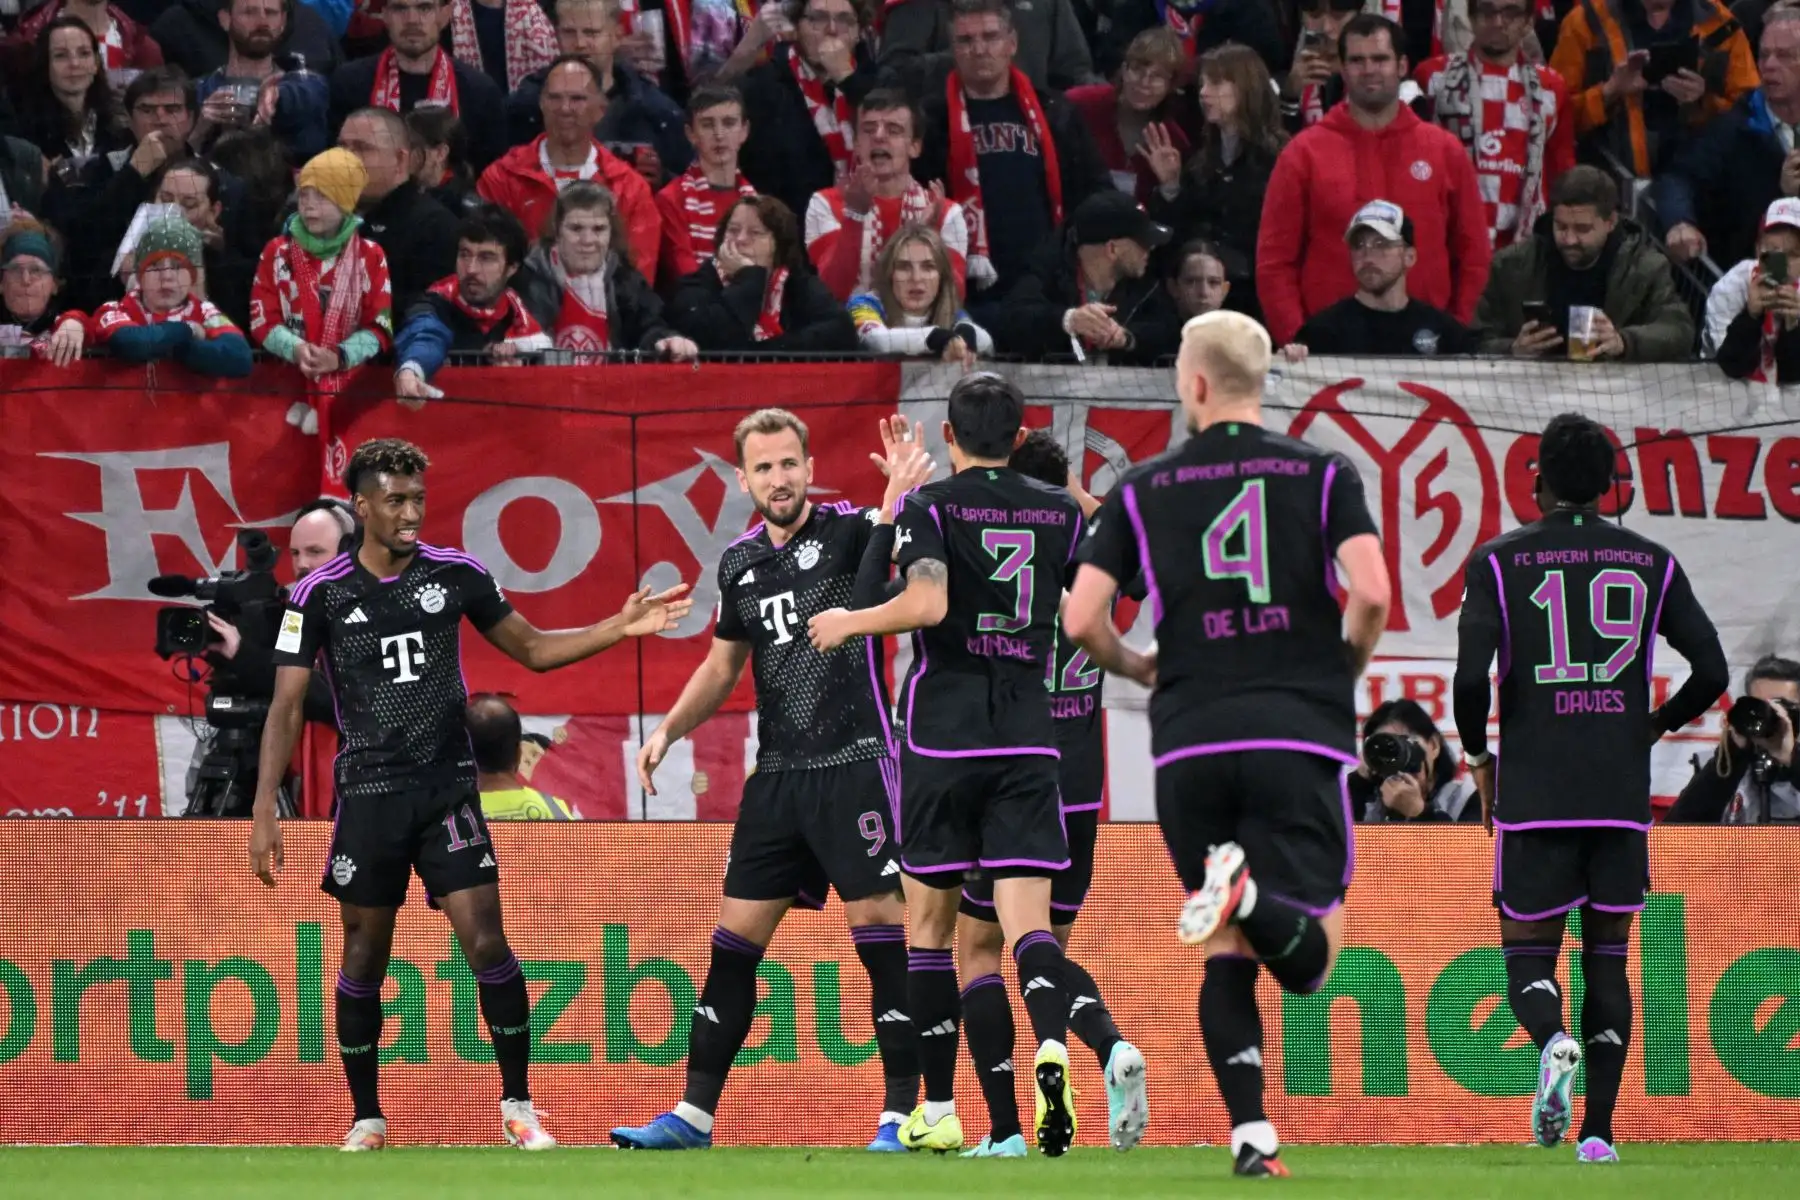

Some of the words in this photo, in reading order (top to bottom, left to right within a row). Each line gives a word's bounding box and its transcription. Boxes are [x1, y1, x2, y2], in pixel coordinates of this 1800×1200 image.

[971, 121, 1038, 156] ANT
[961, 507, 1007, 523] BAYERN
[1201, 477, 1272, 604] 4
[1514, 552, 1531, 566] FC
[1536, 549, 1588, 564] BAYERN
[976, 527, 1035, 634] 3
[760, 590, 798, 645] T
[1529, 568, 1648, 684] 19
[380, 630, 426, 684] T
[1555, 690, 1625, 714] DAVIES
[441, 803, 488, 853] 11
[857, 810, 887, 857] 9
